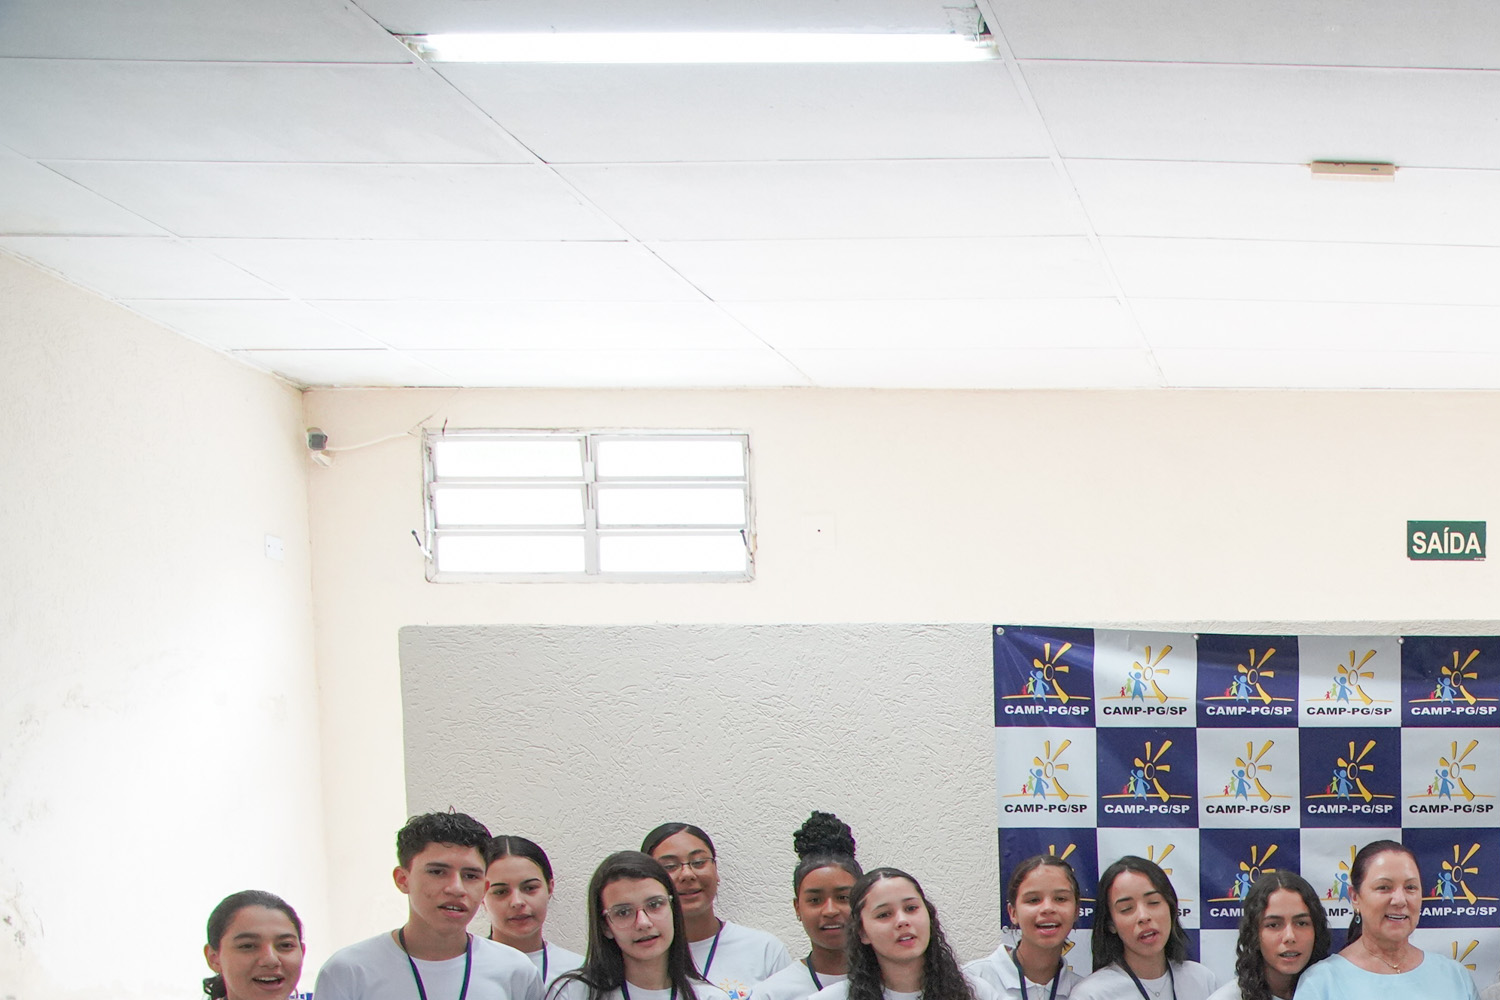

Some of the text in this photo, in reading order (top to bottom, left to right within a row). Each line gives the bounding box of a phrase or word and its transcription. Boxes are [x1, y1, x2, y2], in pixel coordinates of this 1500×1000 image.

[1412, 527, 1482, 554] SAÍDA
[1004, 704, 1090, 716] CAMP-PG/SP
[1102, 705, 1188, 716] CAMP-PG/SP
[1206, 705, 1293, 716] CAMP-PG/SP
[1306, 706, 1392, 716] CAMP-PG/SP
[1410, 705, 1498, 716] CAMP-PG/SP
[1004, 803, 1088, 814] CAMP-PG/SP
[1104, 803, 1190, 815] CAMP-PG/SP
[1205, 803, 1291, 815] CAMP-PG/SP
[1307, 803, 1393, 815] CAMP-PG/SP
[1409, 803, 1494, 814] CAMP-PG/SP
